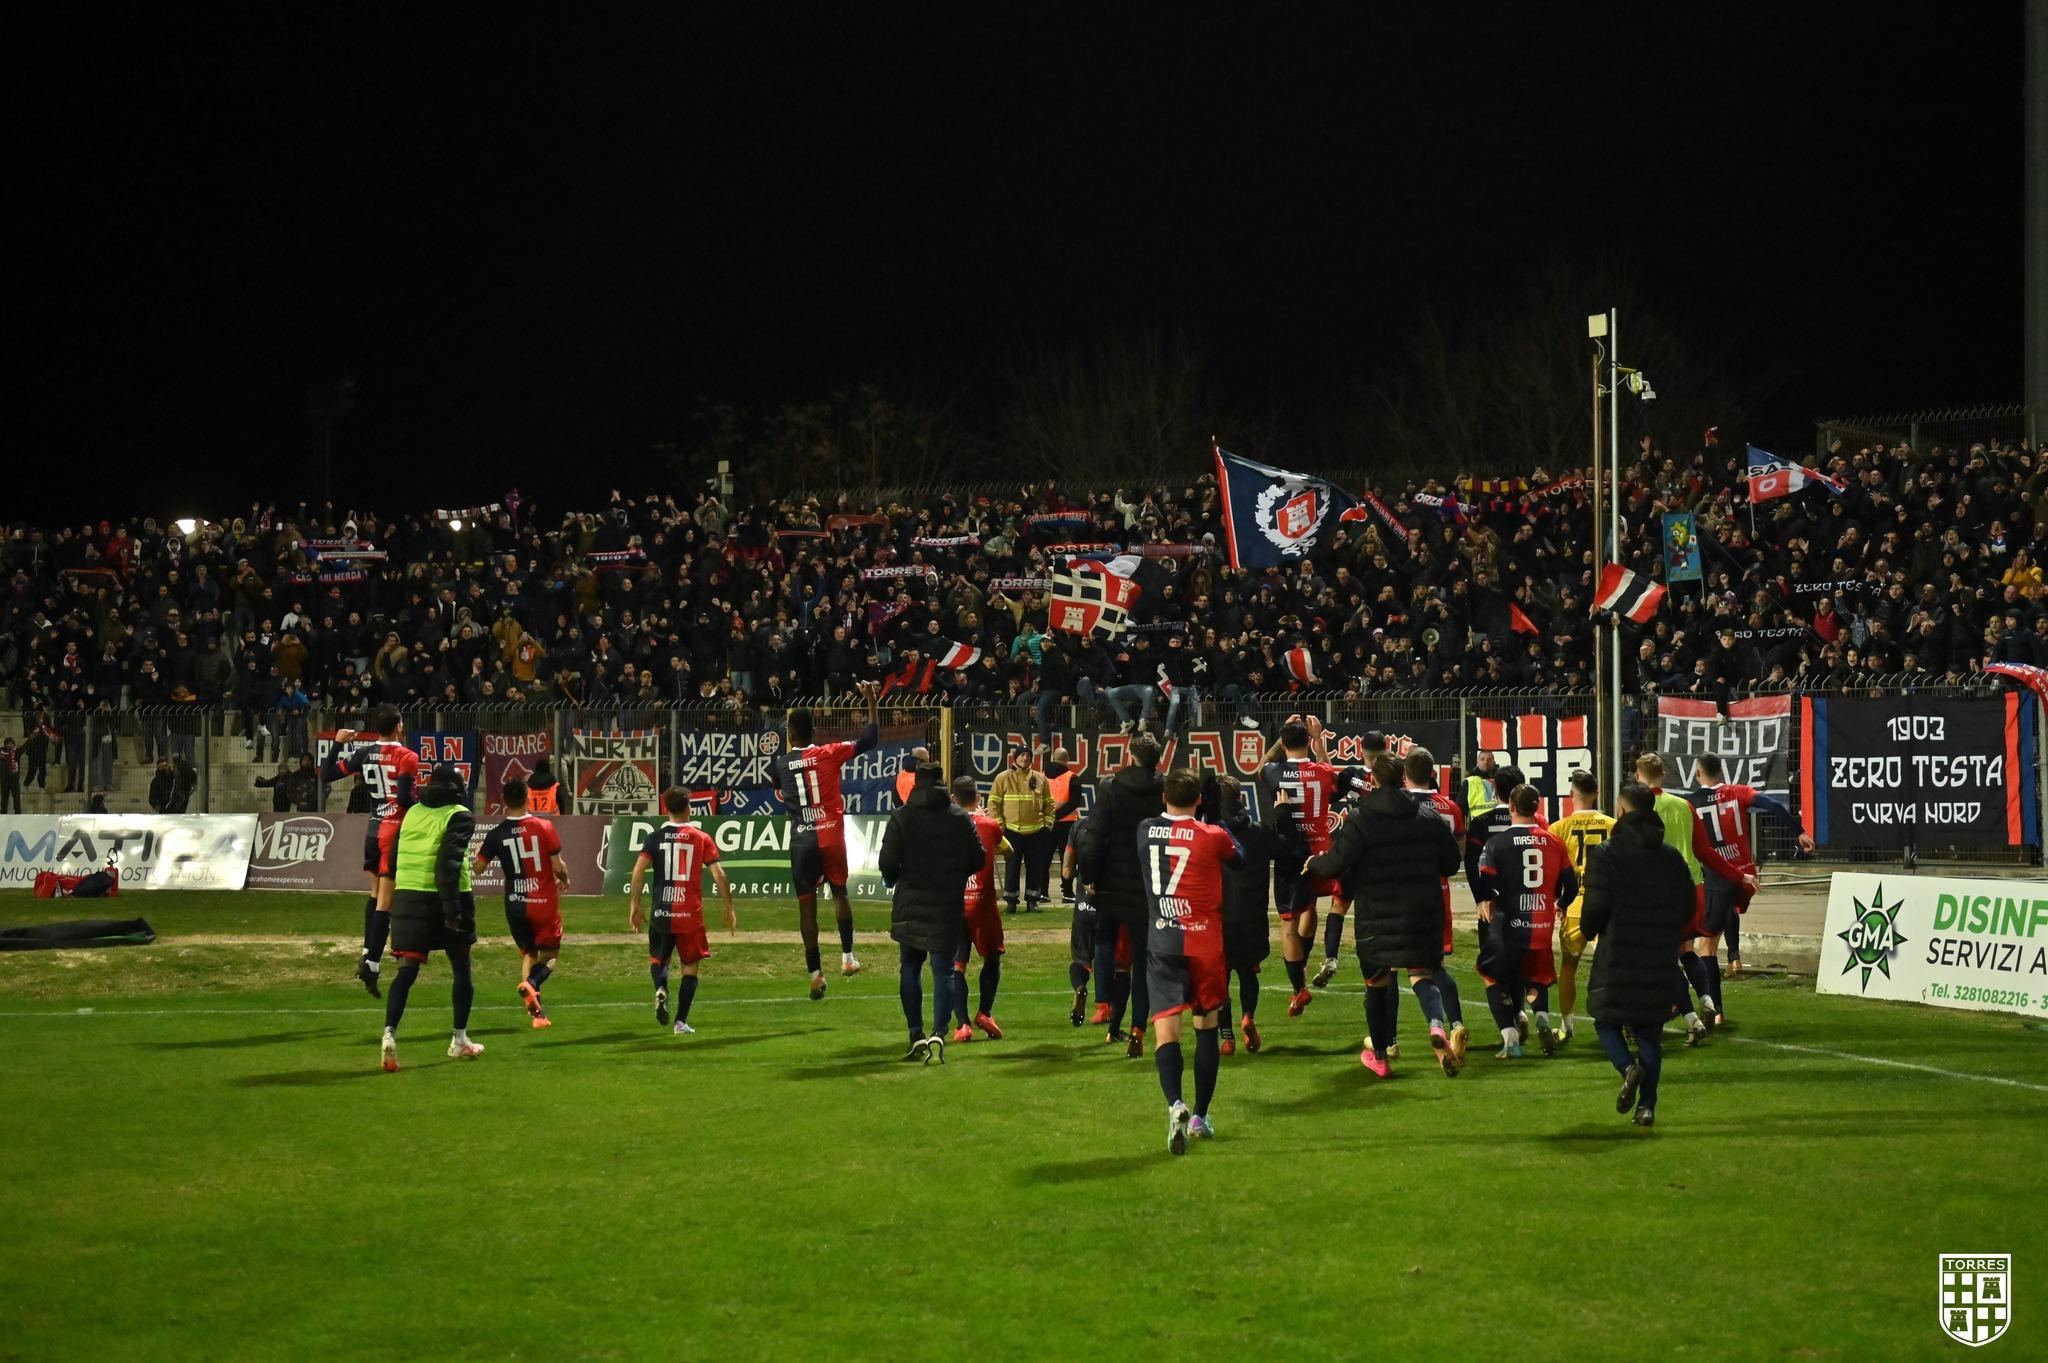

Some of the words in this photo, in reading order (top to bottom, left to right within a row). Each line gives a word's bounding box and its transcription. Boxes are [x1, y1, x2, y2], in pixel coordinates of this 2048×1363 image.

[1043, 543, 1113, 554] TORRES
[865, 566, 924, 577] TORRES
[994, 578, 1052, 588] TORRES
[1836, 579, 1882, 597] TESA
[1663, 717, 1781, 756] FABIO
[1886, 715, 1945, 742] 1903
[485, 732, 547, 756] SQUARE
[574, 736, 657, 759] NORTH
[680, 732, 737, 758] MADE
[741, 732, 758, 758] IN
[682, 755, 774, 787] SASSAR
[1282, 769, 1316, 779] MASTINU
[1675, 756, 1768, 789] VVE
[1831, 755, 1902, 788] ZERO
[1912, 754, 2003, 788] TESTA
[794, 770, 821, 806] 11
[1696, 799, 1744, 842] 77
[1852, 802, 1916, 824] CURVA
[1925, 801, 1981, 824] NORD
[1148, 826, 1194, 841] GOGLINO
[1513, 835, 1547, 846] MASALA
[502, 835, 542, 874] 14
[659, 842, 695, 882] 10
[1149, 844, 1191, 896] 17
[1522, 848, 1544, 888] 8
[662, 885, 686, 903] OBUS
[729, 882, 791, 894] PARCHI
[857, 883, 875, 895] SU
[1932, 893, 2048, 938] DISINF
[1848, 921, 1894, 951] GMA
[1926, 937, 2023, 973] SERVIZI
[1931, 982, 1950, 999] Tel.
[1954, 985, 2028, 1008] 3281082216
